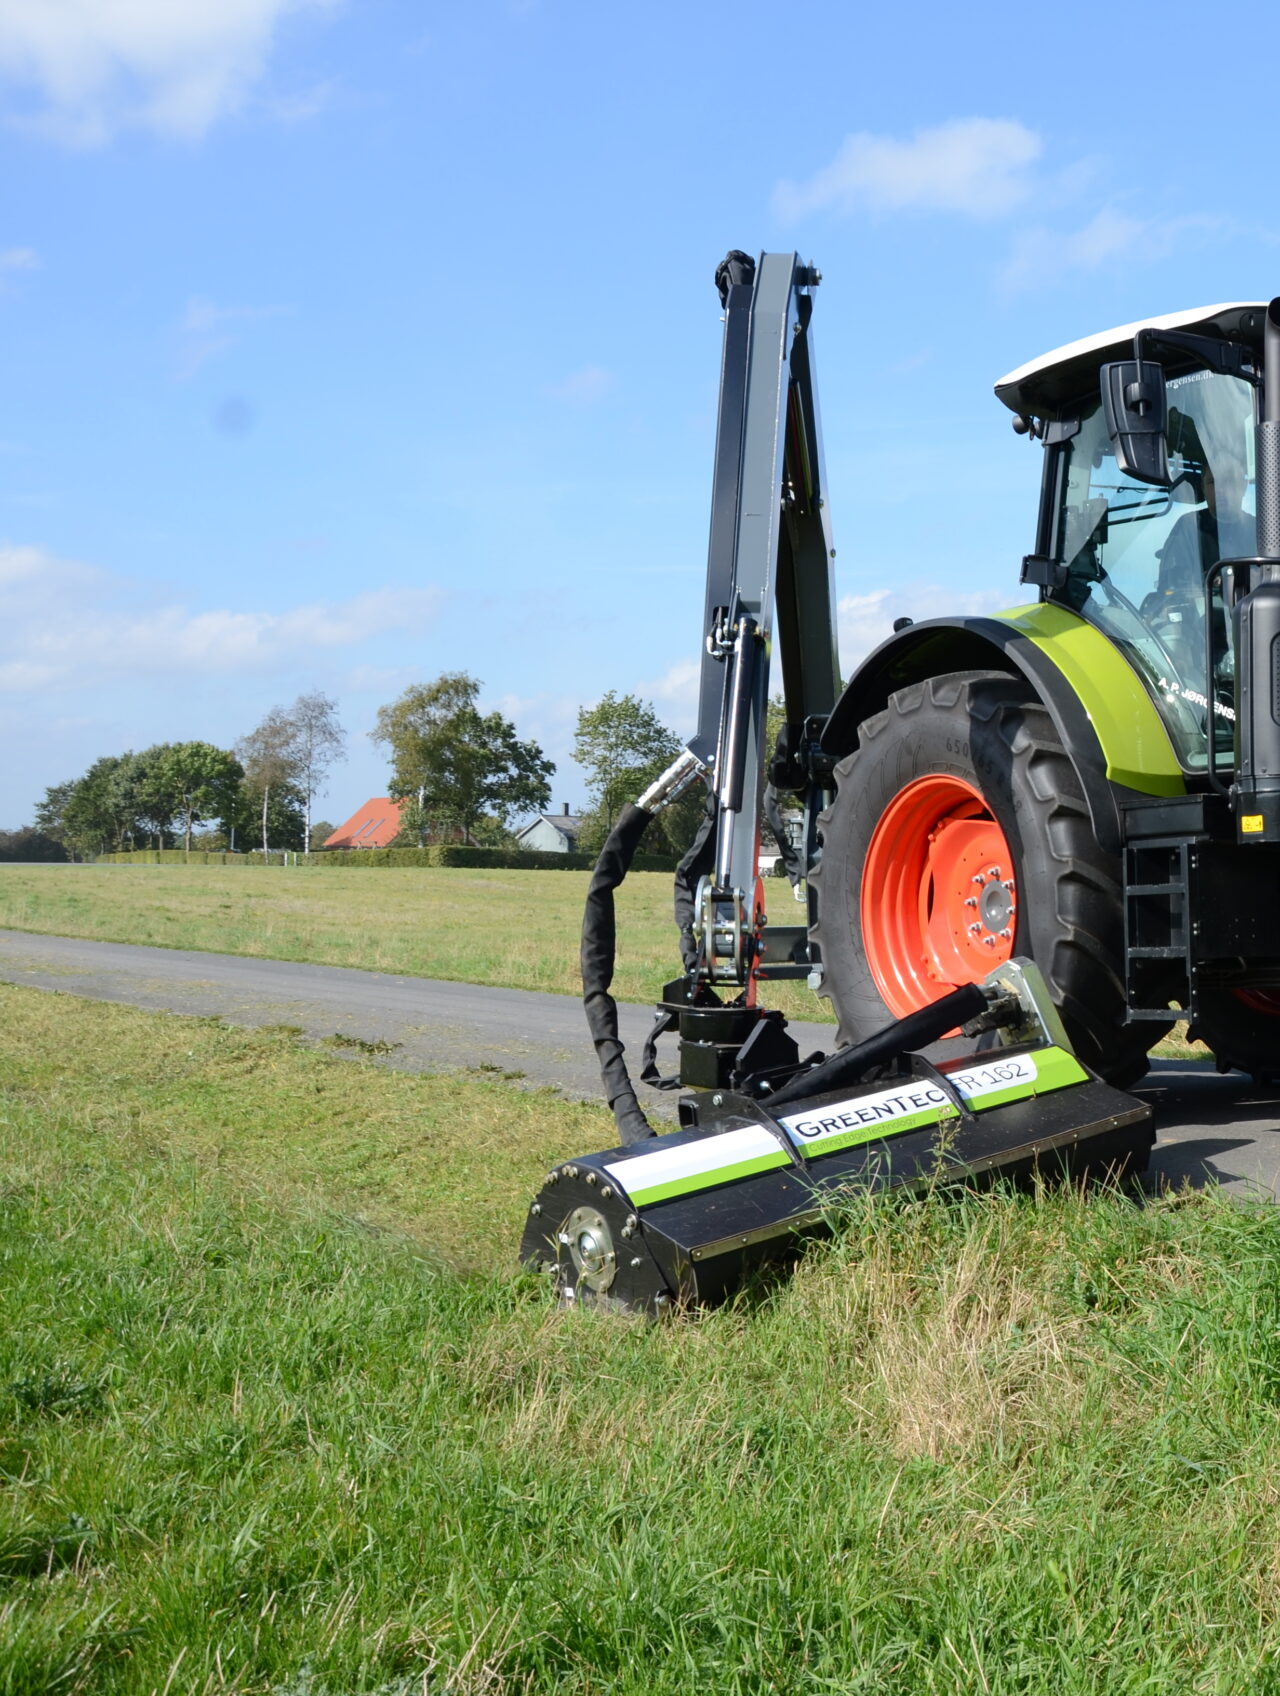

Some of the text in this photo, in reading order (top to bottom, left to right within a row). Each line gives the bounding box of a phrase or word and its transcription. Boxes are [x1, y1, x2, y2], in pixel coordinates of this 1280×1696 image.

[1166, 369, 1215, 389] ergensen.dk
[1158, 677, 1236, 721] A. P. JØRENS
[981, 1063, 1029, 1085] 162
[808, 1117, 917, 1152] Cutting Edge Technology
